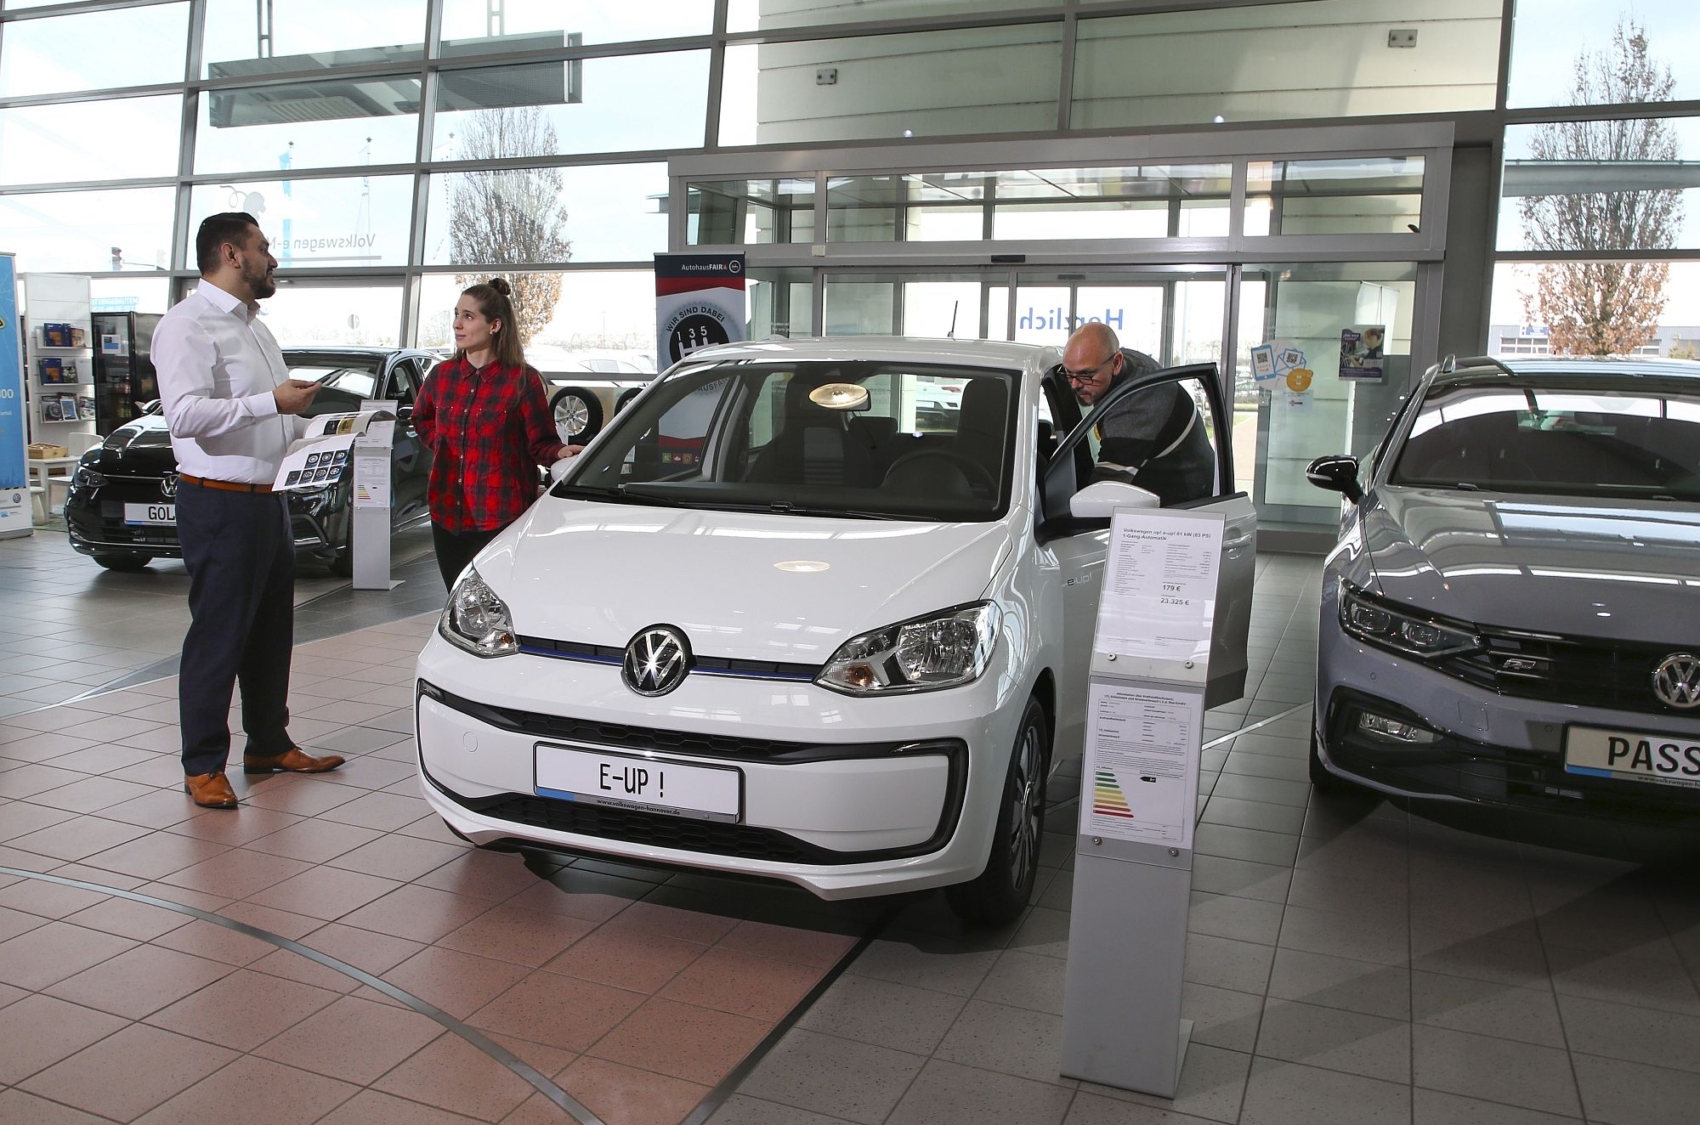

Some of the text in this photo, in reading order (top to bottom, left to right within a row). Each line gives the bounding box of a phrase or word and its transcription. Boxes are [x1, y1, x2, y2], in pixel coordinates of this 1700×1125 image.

[666, 306, 725, 332] WIR SIND DABEI
[677, 325, 708, 341] 1 3 5
[0, 388, 14, 399] 00
[1160, 597, 1183, 605] 23.325
[1607, 736, 1700, 776] PASS
[599, 763, 664, 798] E-UP !
[597, 799, 680, 816] www.volkswagen-hannover.de
